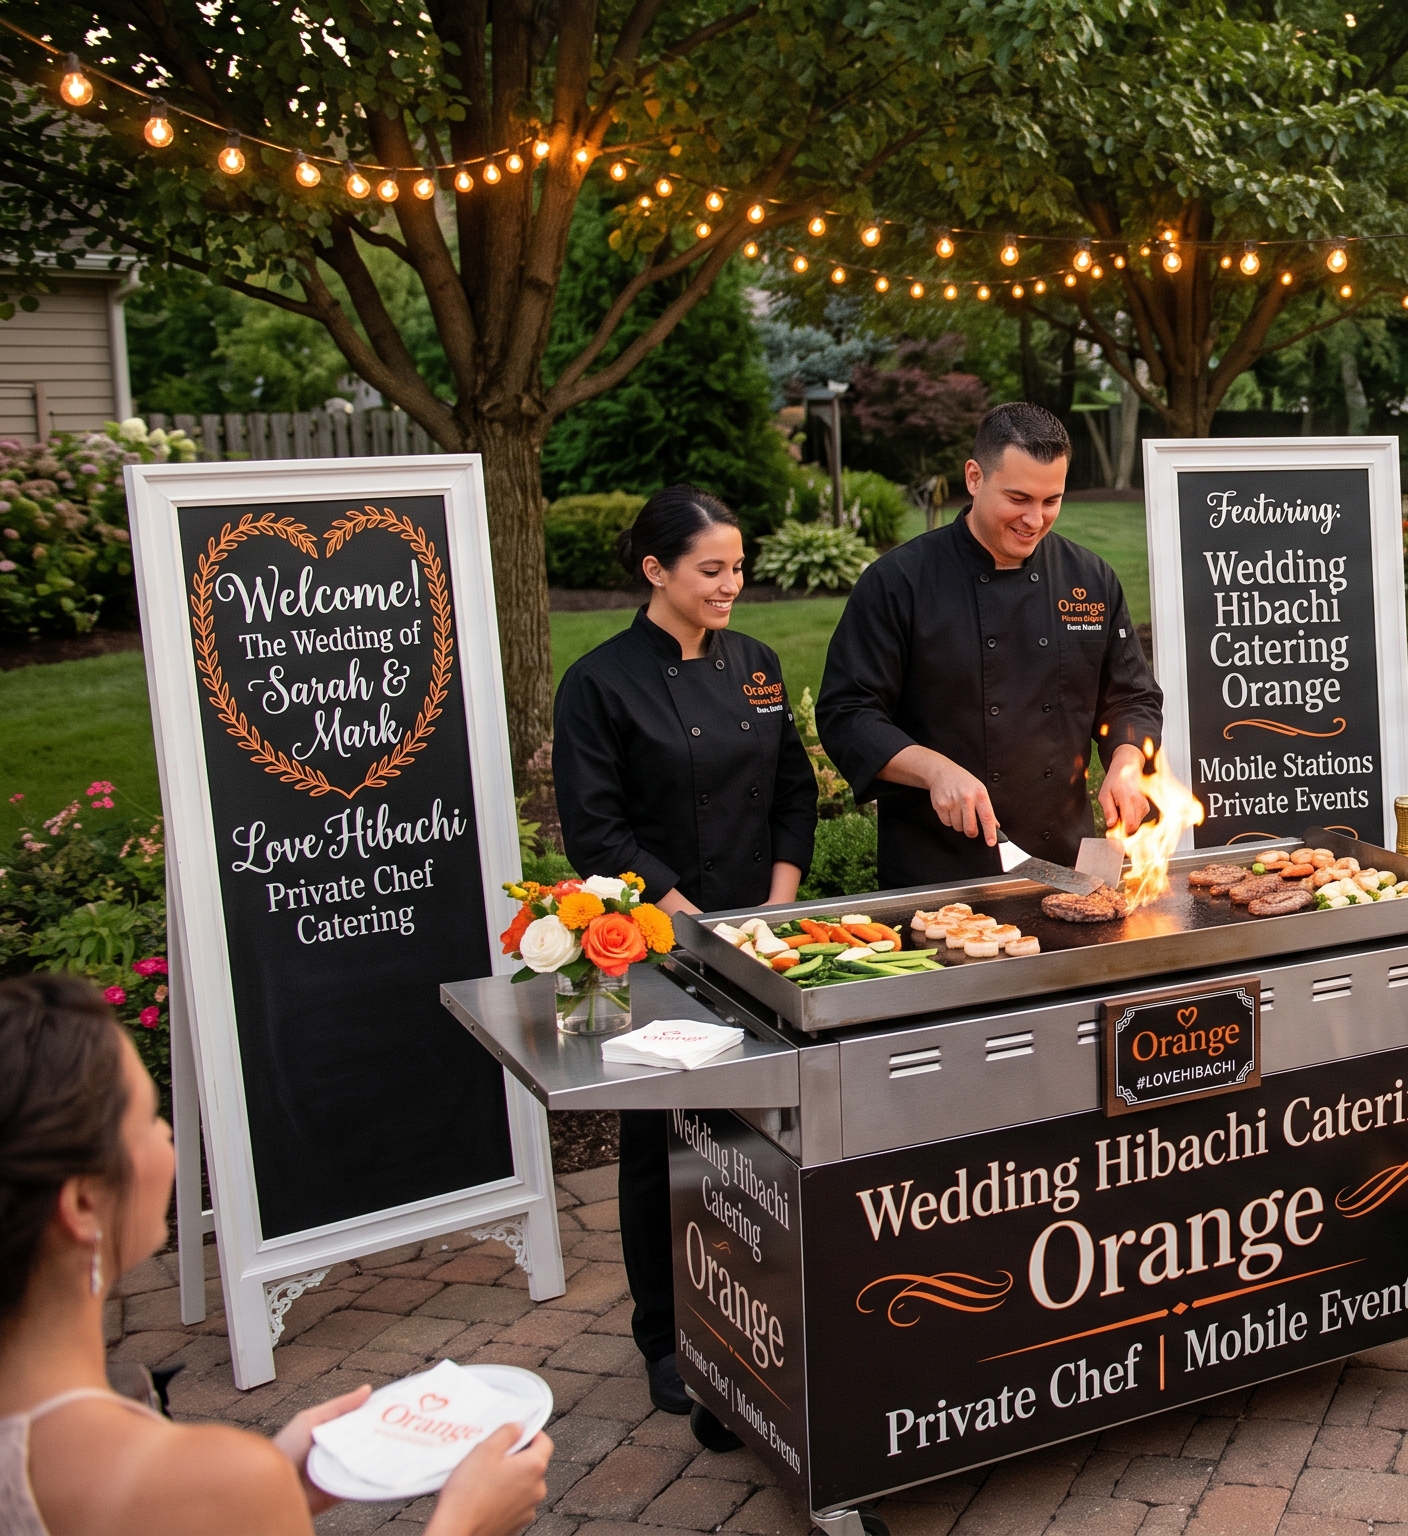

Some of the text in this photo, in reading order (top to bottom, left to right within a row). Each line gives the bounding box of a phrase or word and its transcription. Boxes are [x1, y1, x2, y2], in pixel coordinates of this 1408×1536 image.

[1207, 490, 1341, 534] Featuring:
[216, 559, 421, 623] Welcome!
[1203, 550, 1347, 592] Wedding
[1058, 599, 1105, 616] Orange
[1214, 589, 1341, 627] Hibachi
[239, 620, 422, 659] The Wedding of
[1210, 630, 1349, 671] Catering
[248, 658, 410, 714] Sarah &
[1222, 672, 1341, 713] Orange
[292, 702, 402, 760] Mark
[1199, 750, 1373, 784] Mobile Stations
[1208, 786, 1369, 818] Private Events
[232, 798, 466, 873] Love Hibachi
[266, 859, 434, 912] Private Chef
[297, 905, 415, 944] Catering
[1132, 1023, 1240, 1061] Orange
[1136, 1060, 1236, 1090] #LOVEHIBACHI
[673, 1108, 790, 1231] Wedding Hibachi
[856, 1155, 1081, 1241] Wedding
[1095, 1108, 1269, 1191] Hibachi
[702, 1175, 762, 1263] Catering
[1028, 1186, 1324, 1310] Orange
[686, 1221, 785, 1369] Orange
[886, 1382, 1036, 1457] Private
[1049, 1344, 1142, 1411] Chef
[1184, 1302, 1307, 1373] Mobile
[381, 1403, 483, 1443] Orange
[736, 1388, 768, 1440] Mobile
